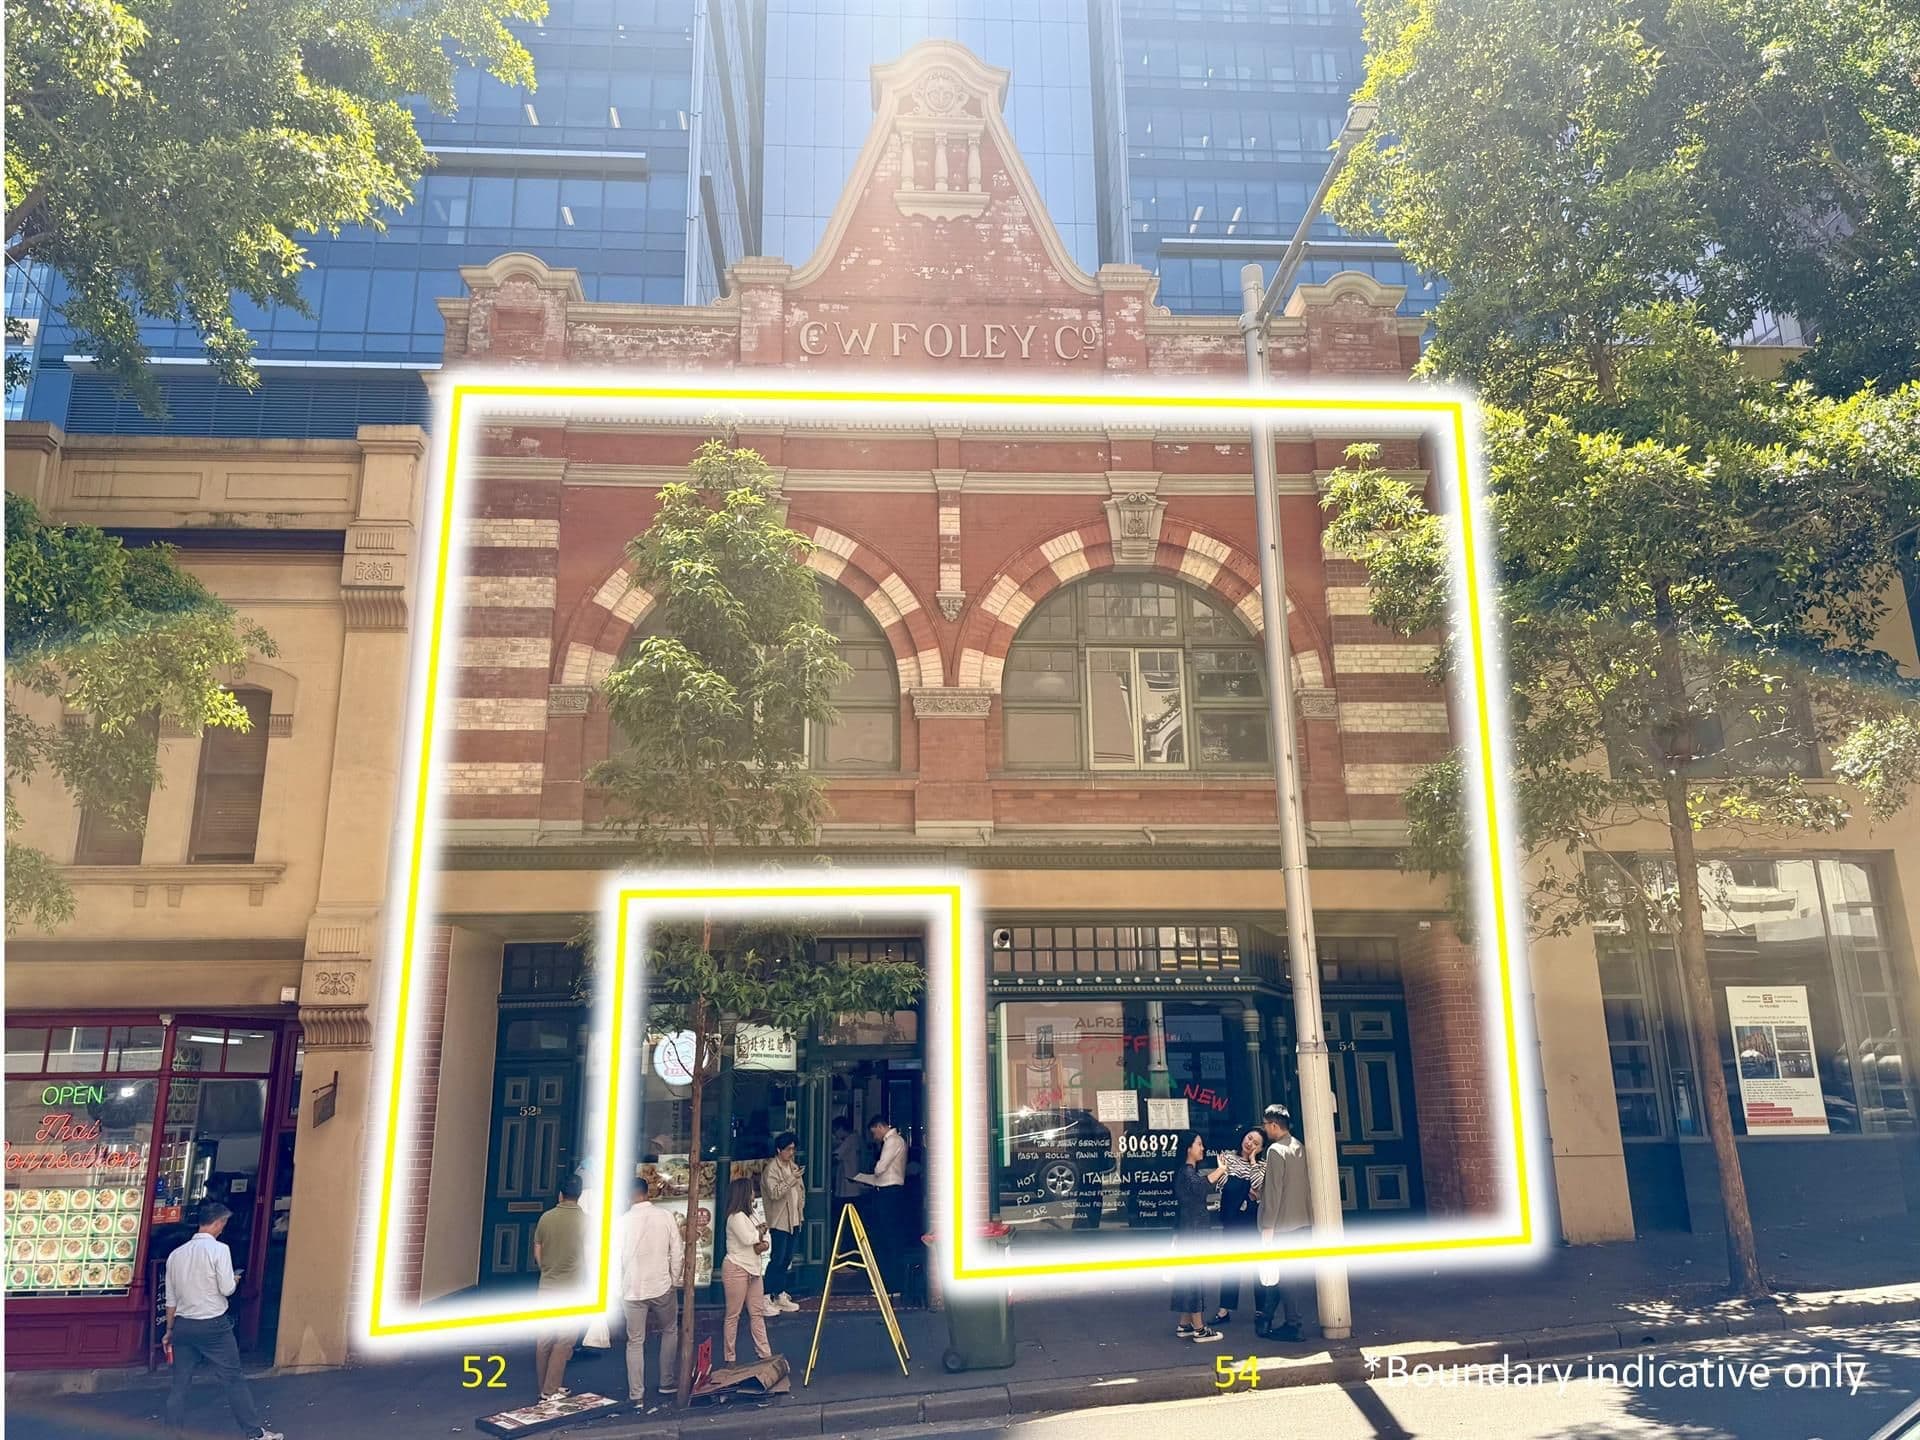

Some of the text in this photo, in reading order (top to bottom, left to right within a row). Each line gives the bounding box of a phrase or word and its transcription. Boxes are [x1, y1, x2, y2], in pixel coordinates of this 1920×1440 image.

[891, 322, 1037, 359] FOLEY
[1339, 1041, 1357, 1051] 54
[41, 1085, 104, 1106] OPEN
[1183, 1084, 1230, 1112] NEW
[519, 1105, 537, 1117] 52
[35, 1112, 101, 1143] Thai
[1078, 1138, 1111, 1147] SERVICE
[1118, 1134, 1179, 1152] 806892
[4, 1140, 141, 1171] onnection
[1017, 1151, 1040, 1161] PASTA
[1075, 1151, 1099, 1160] PANINI
[1126, 1150, 1157, 1158] SALADS
[1016, 1172, 1037, 1189] HOT
[1082, 1170, 1176, 1185] ITALIAN FEAST
[1016, 1188, 1046, 1208] FOD
